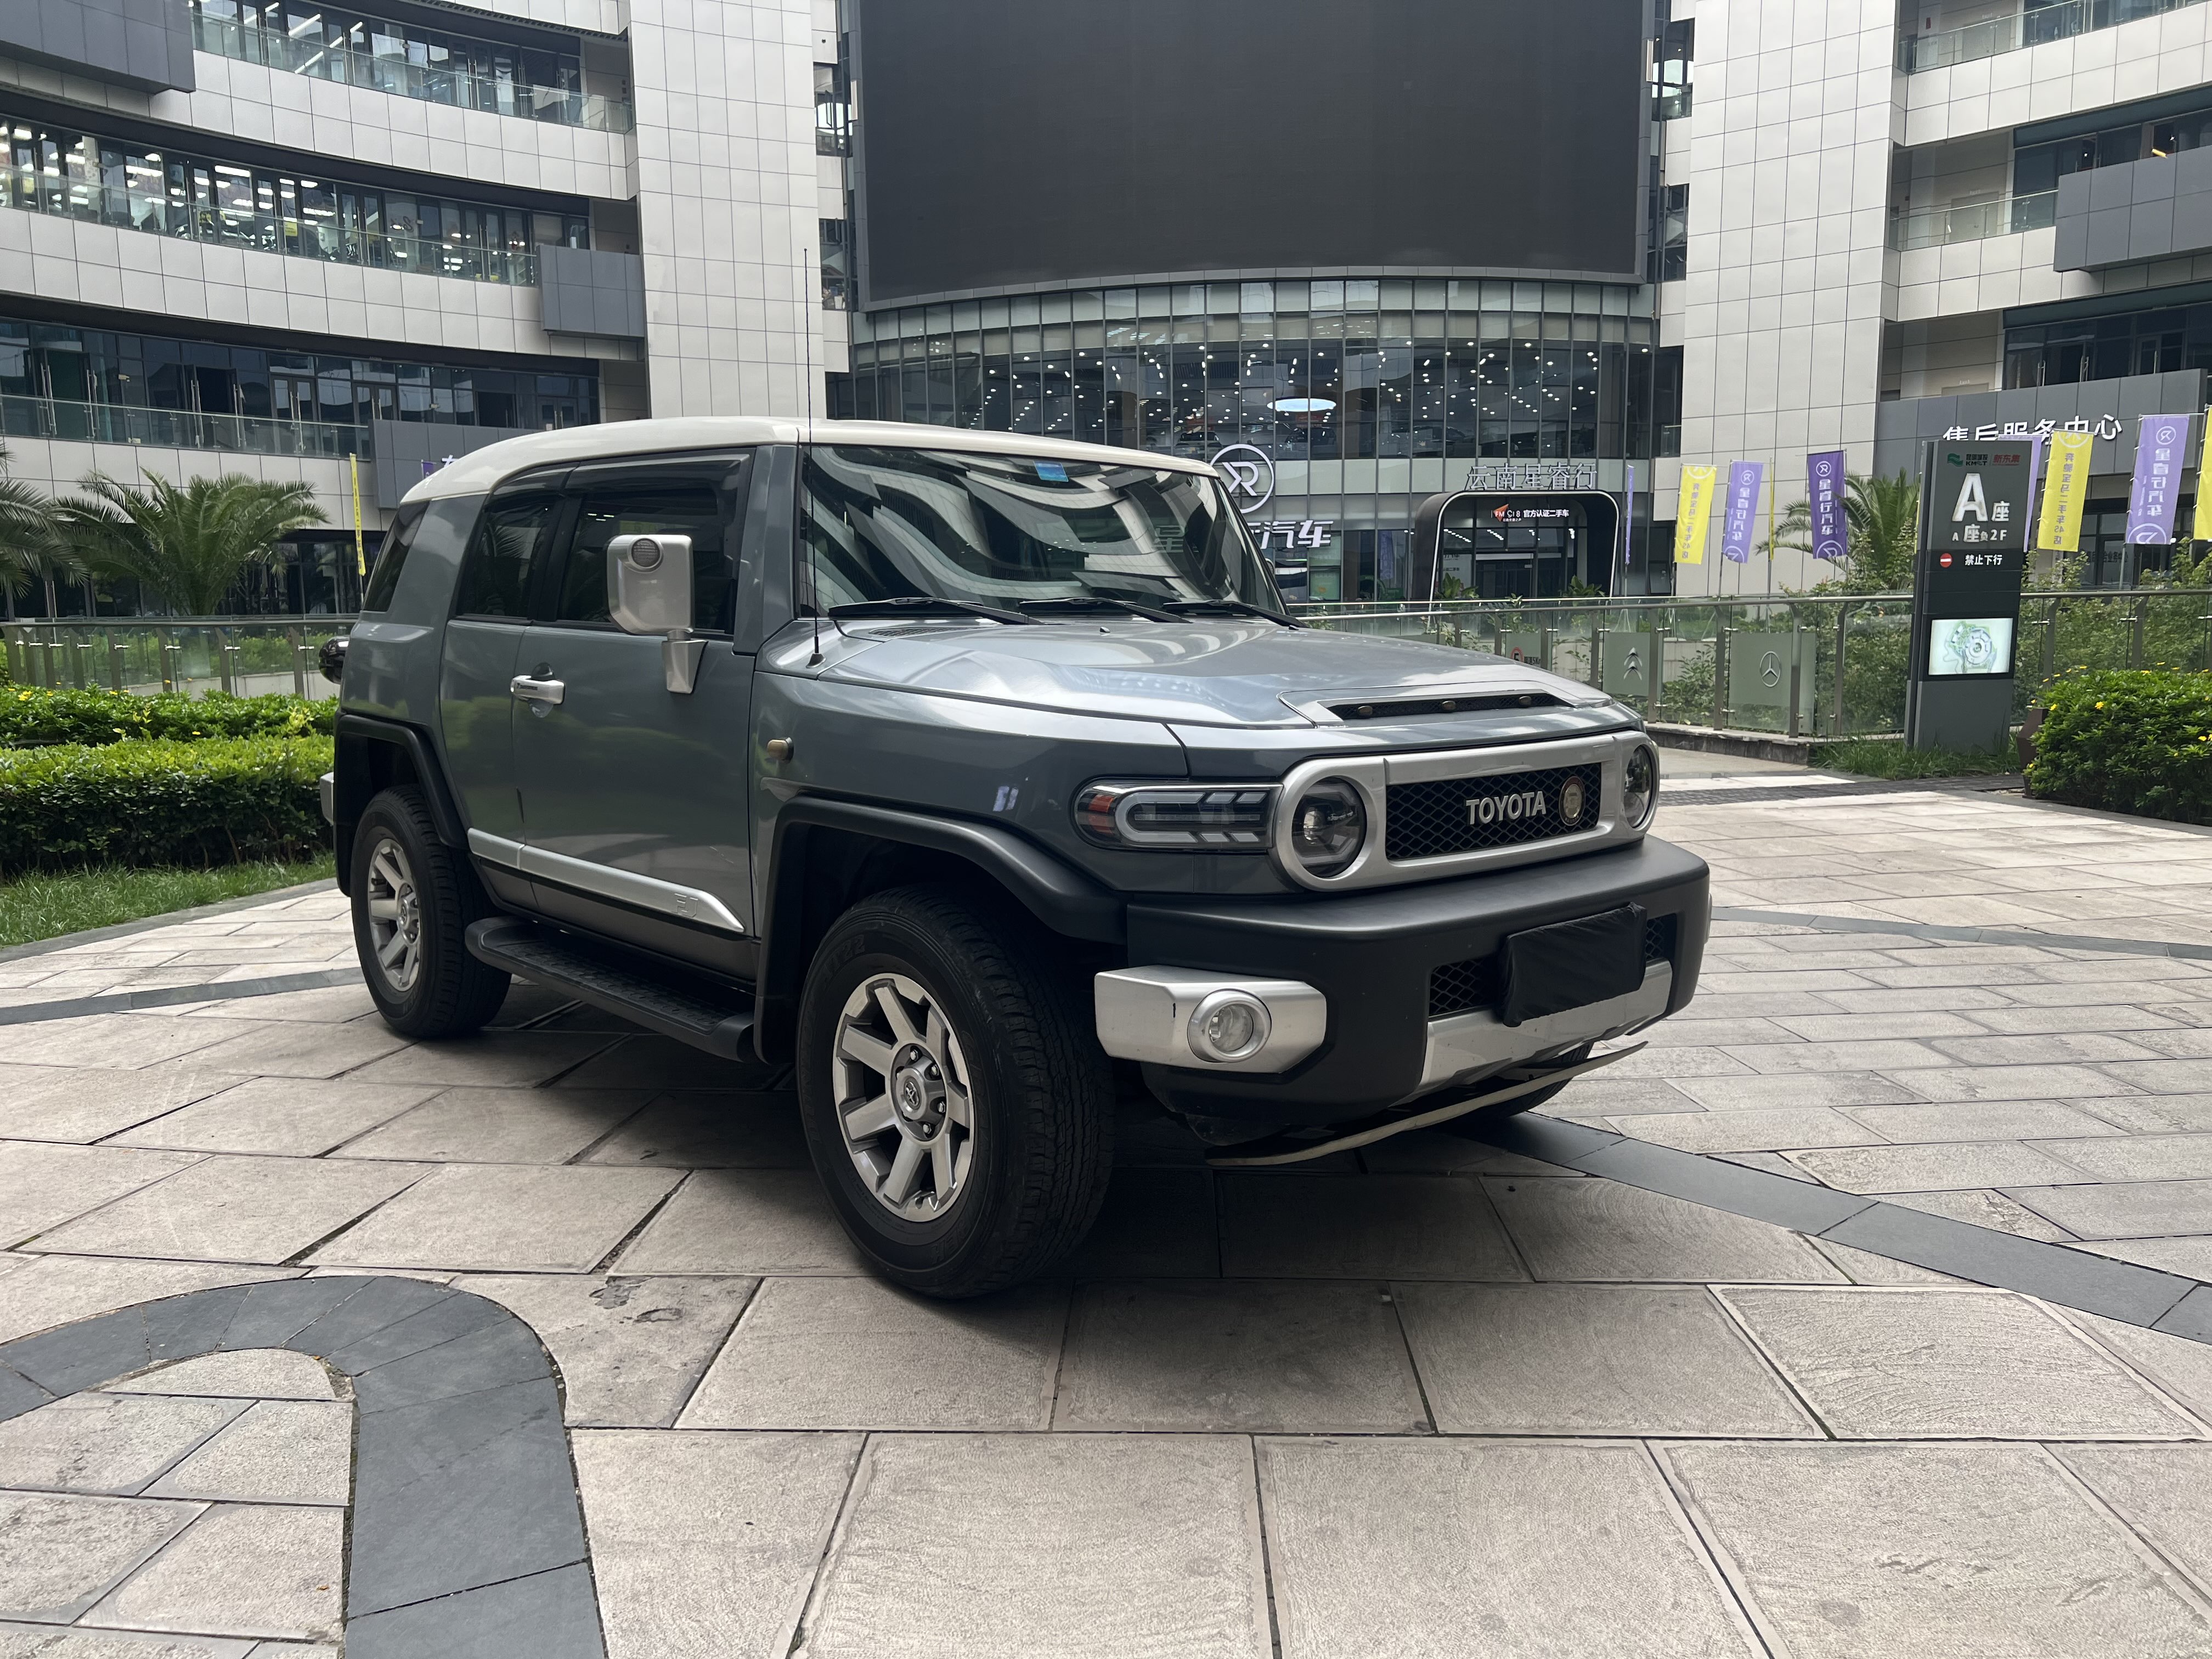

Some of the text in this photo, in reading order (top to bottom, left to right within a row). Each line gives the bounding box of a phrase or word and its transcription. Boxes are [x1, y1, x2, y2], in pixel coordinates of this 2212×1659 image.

[1466, 462, 1597, 490] 云南星睿行
[1523, 509, 1569, 518] 官方认证二手车
[1965, 554, 2002, 566] 禁止下行
[1466, 791, 1547, 825] TOYOTA
